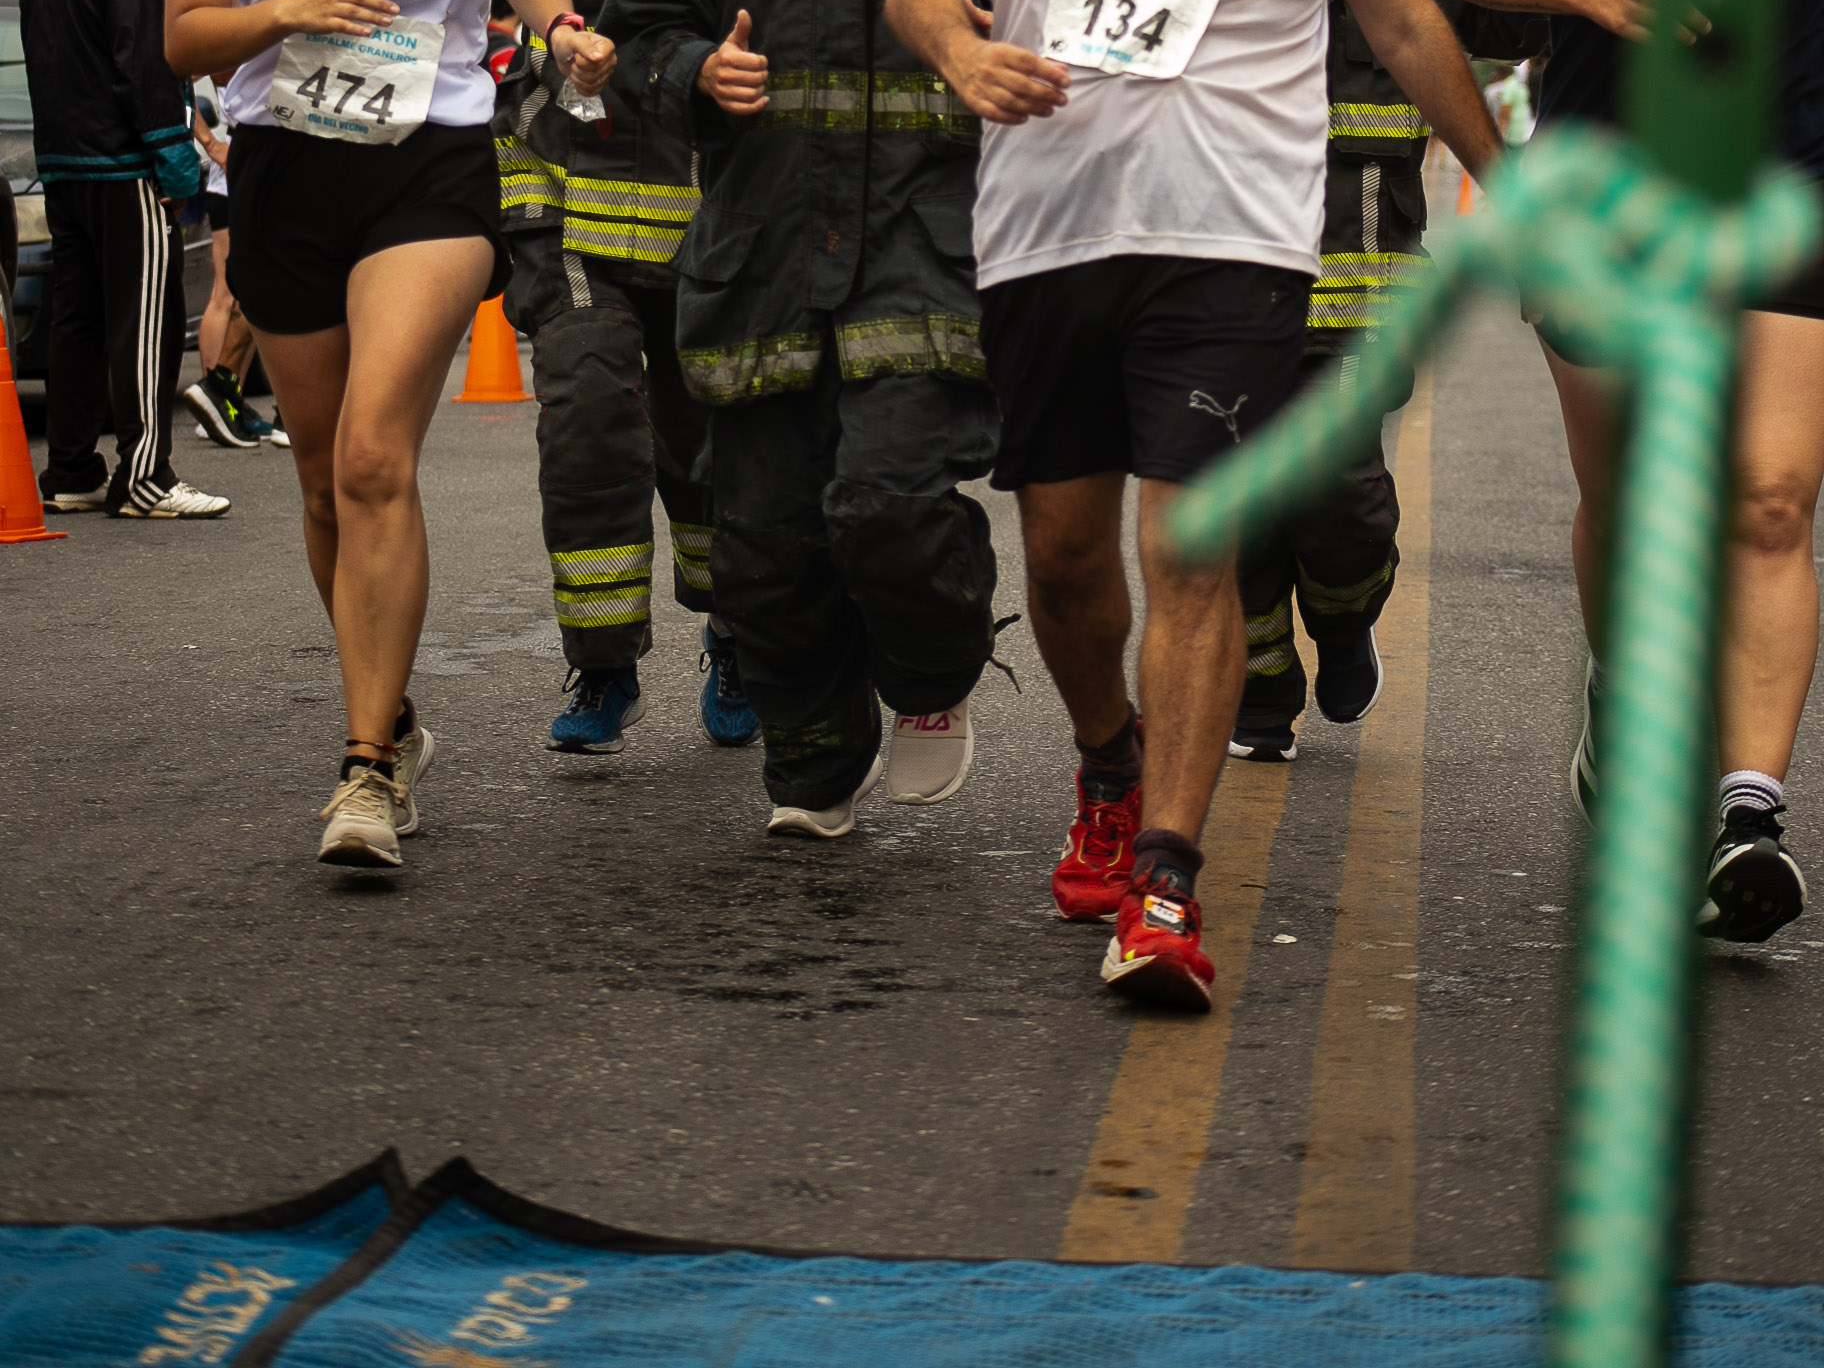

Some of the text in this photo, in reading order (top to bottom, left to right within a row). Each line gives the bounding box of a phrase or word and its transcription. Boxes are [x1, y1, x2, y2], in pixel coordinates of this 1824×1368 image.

[366, 29, 418, 50] ATON
[305, 34, 418, 66] EMPALME GRANEROS
[296, 65, 396, 125] 474
[272, 104, 295, 120] NEJ
[323, 116, 338, 129] DEL
[339, 119, 370, 135] VECINO
[898, 713, 950, 732] FILA
